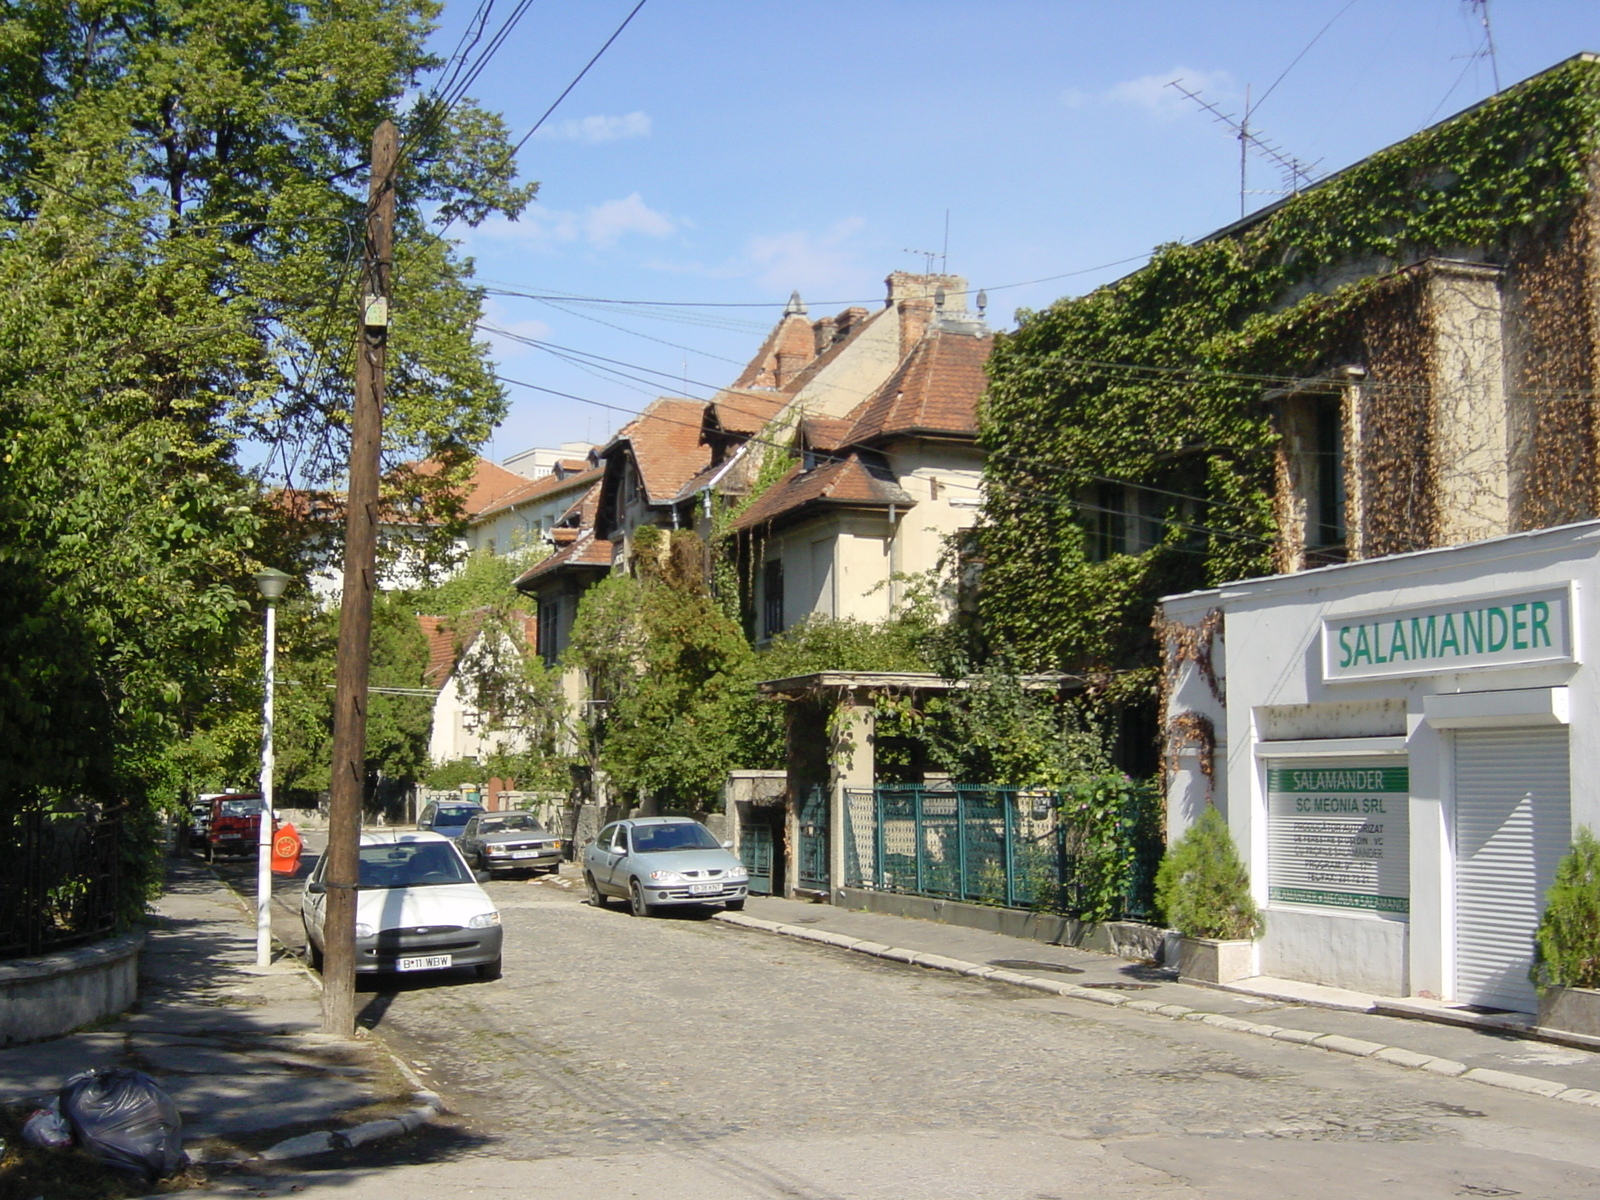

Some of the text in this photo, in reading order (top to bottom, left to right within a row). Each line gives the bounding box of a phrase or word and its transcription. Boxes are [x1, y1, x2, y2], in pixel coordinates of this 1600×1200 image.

[1338, 600, 1552, 668] SALAMANDER
[1293, 770, 1384, 790] SALAMANDER
[1296, 798, 1386, 813] SC MEONIA SRL
[1334, 847, 1384, 859] SALAMANDER
[403, 957, 448, 968] B 11 WBW
